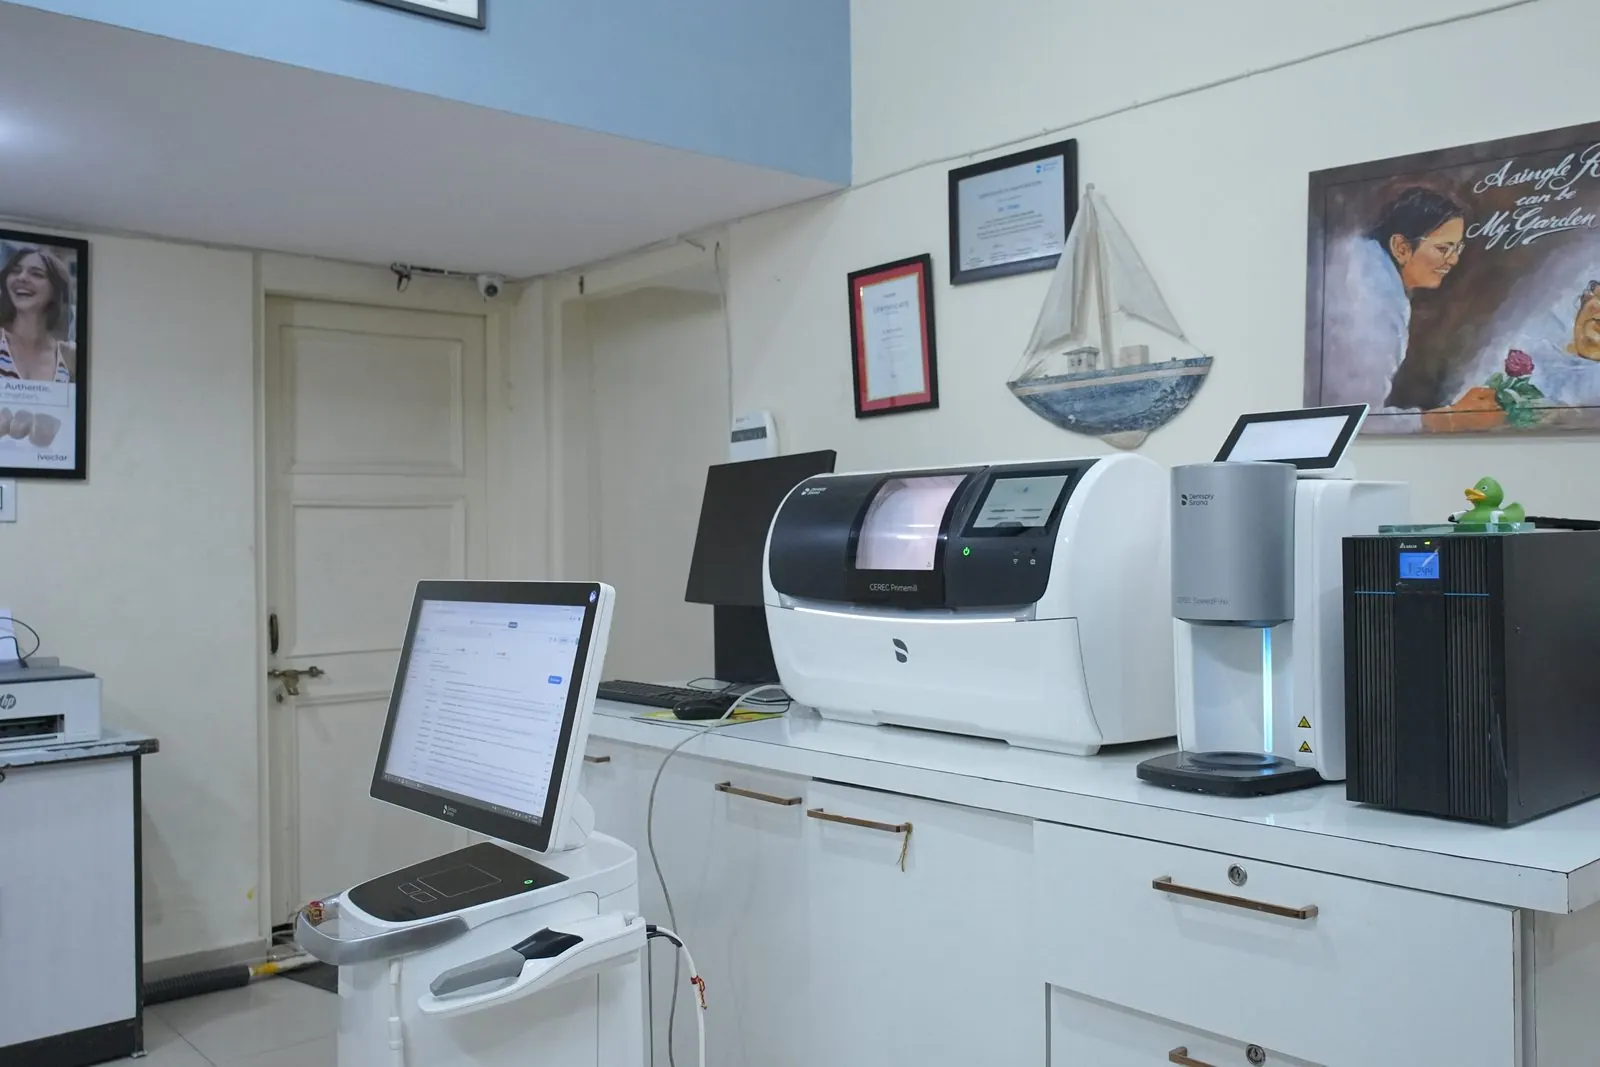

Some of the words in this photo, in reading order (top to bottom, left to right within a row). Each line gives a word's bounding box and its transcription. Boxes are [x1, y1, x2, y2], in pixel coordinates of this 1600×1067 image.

[1473, 160, 1514, 193] A
[1504, 152, 1576, 190] single
[1515, 194, 1551, 206] can
[1554, 186, 1577, 201] be
[1466, 211, 1510, 250] My
[1503, 206, 1597, 250] Garden
[869, 583, 890, 591] CEREC
[0, 693, 17, 711] hp
